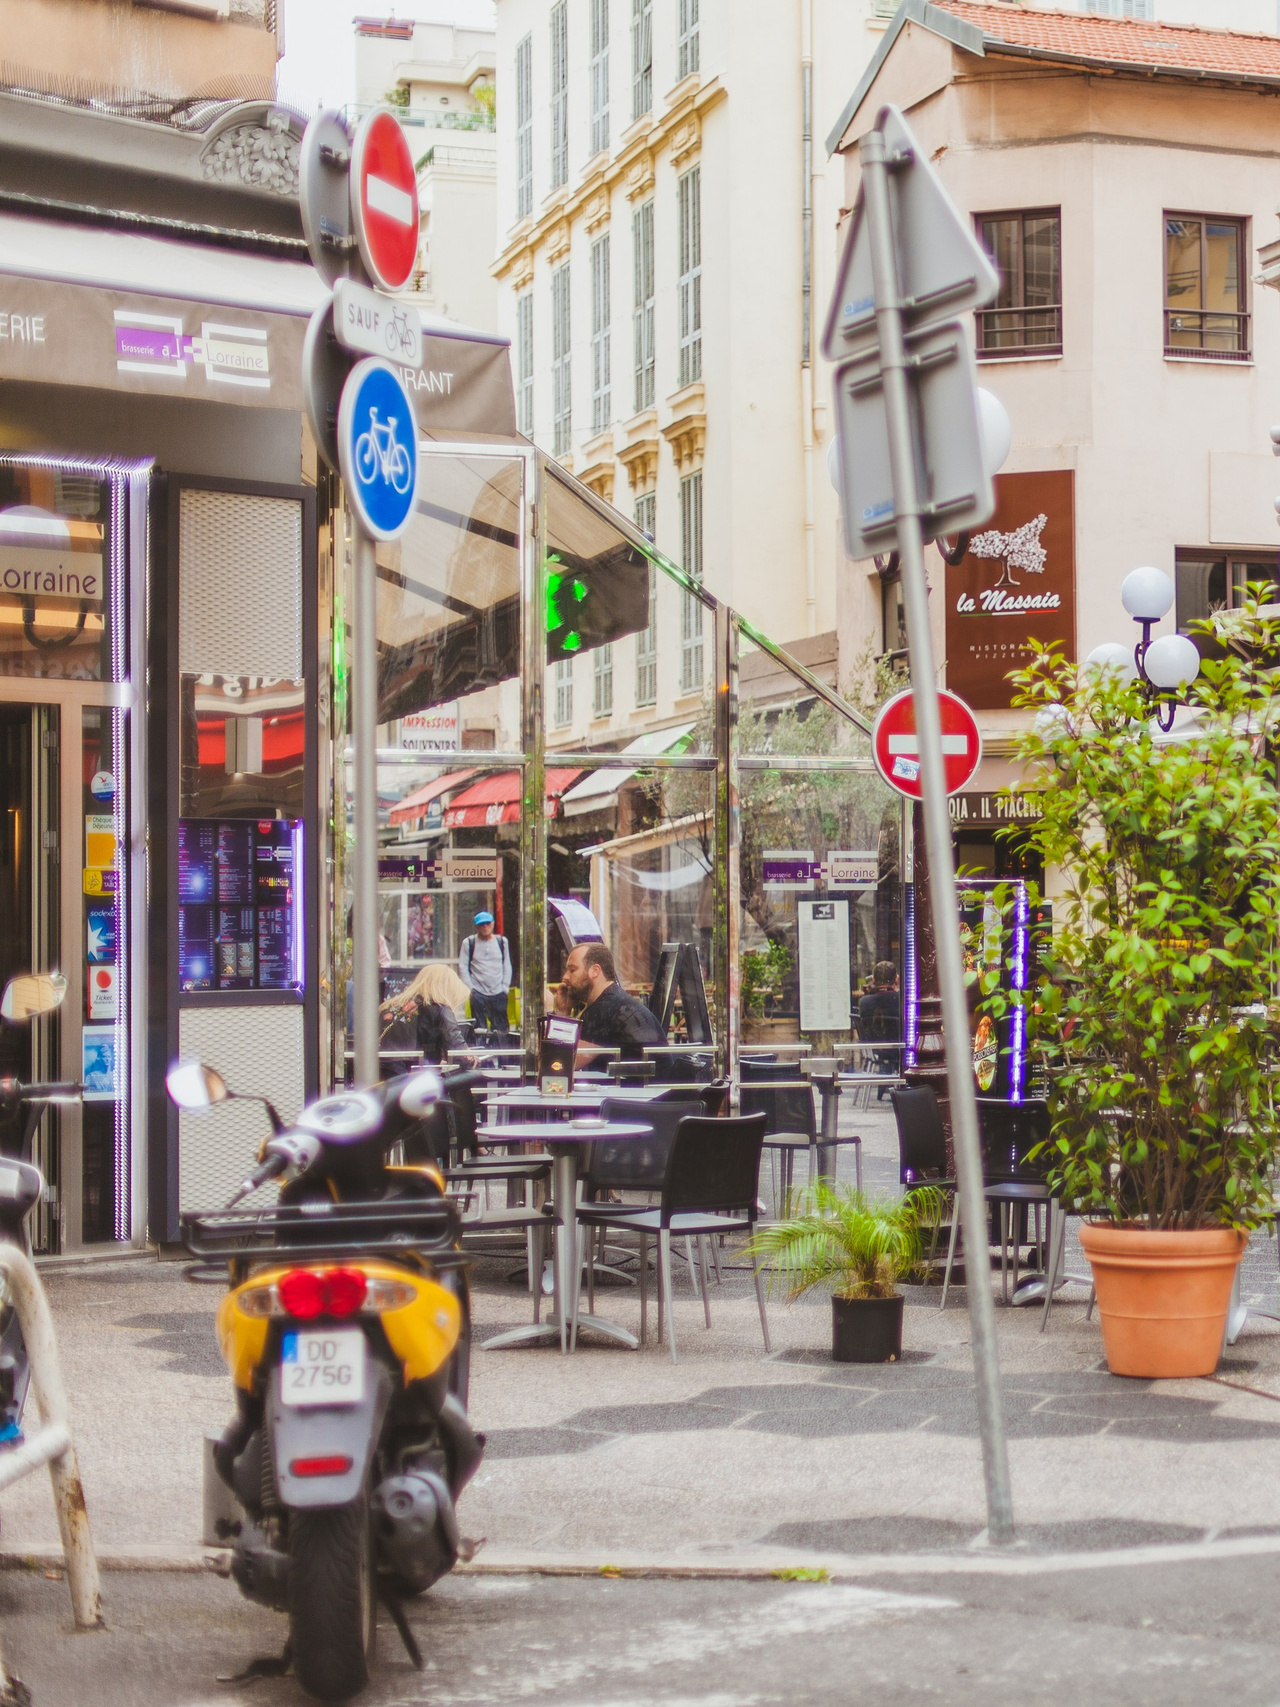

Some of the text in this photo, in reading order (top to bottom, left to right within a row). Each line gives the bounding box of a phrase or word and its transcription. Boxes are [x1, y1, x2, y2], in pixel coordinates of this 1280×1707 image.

[348, 302, 380, 333] SAUF
[121, 340, 154, 356] brasserie
[205, 342, 265, 369] Lorraine
[0, 564, 98, 595] orraine
[956, 589, 1061, 612] la Massaia
[969, 641, 1049, 652] RISTORANE
[975, 652, 1034, 660] PIZZERI
[402, 717, 457, 729] IMPRESSION
[402, 739, 457, 750] SOUVENIRS
[980, 797, 992, 818] IL
[92, 816, 113, 825] Chèque
[445, 862, 494, 877] Lorraine
[767, 870, 792, 878] brasserie
[830, 864, 875, 878] Lorraine
[307, 1339, 338, 1362] DD
[290, 1364, 352, 1389] 275G
